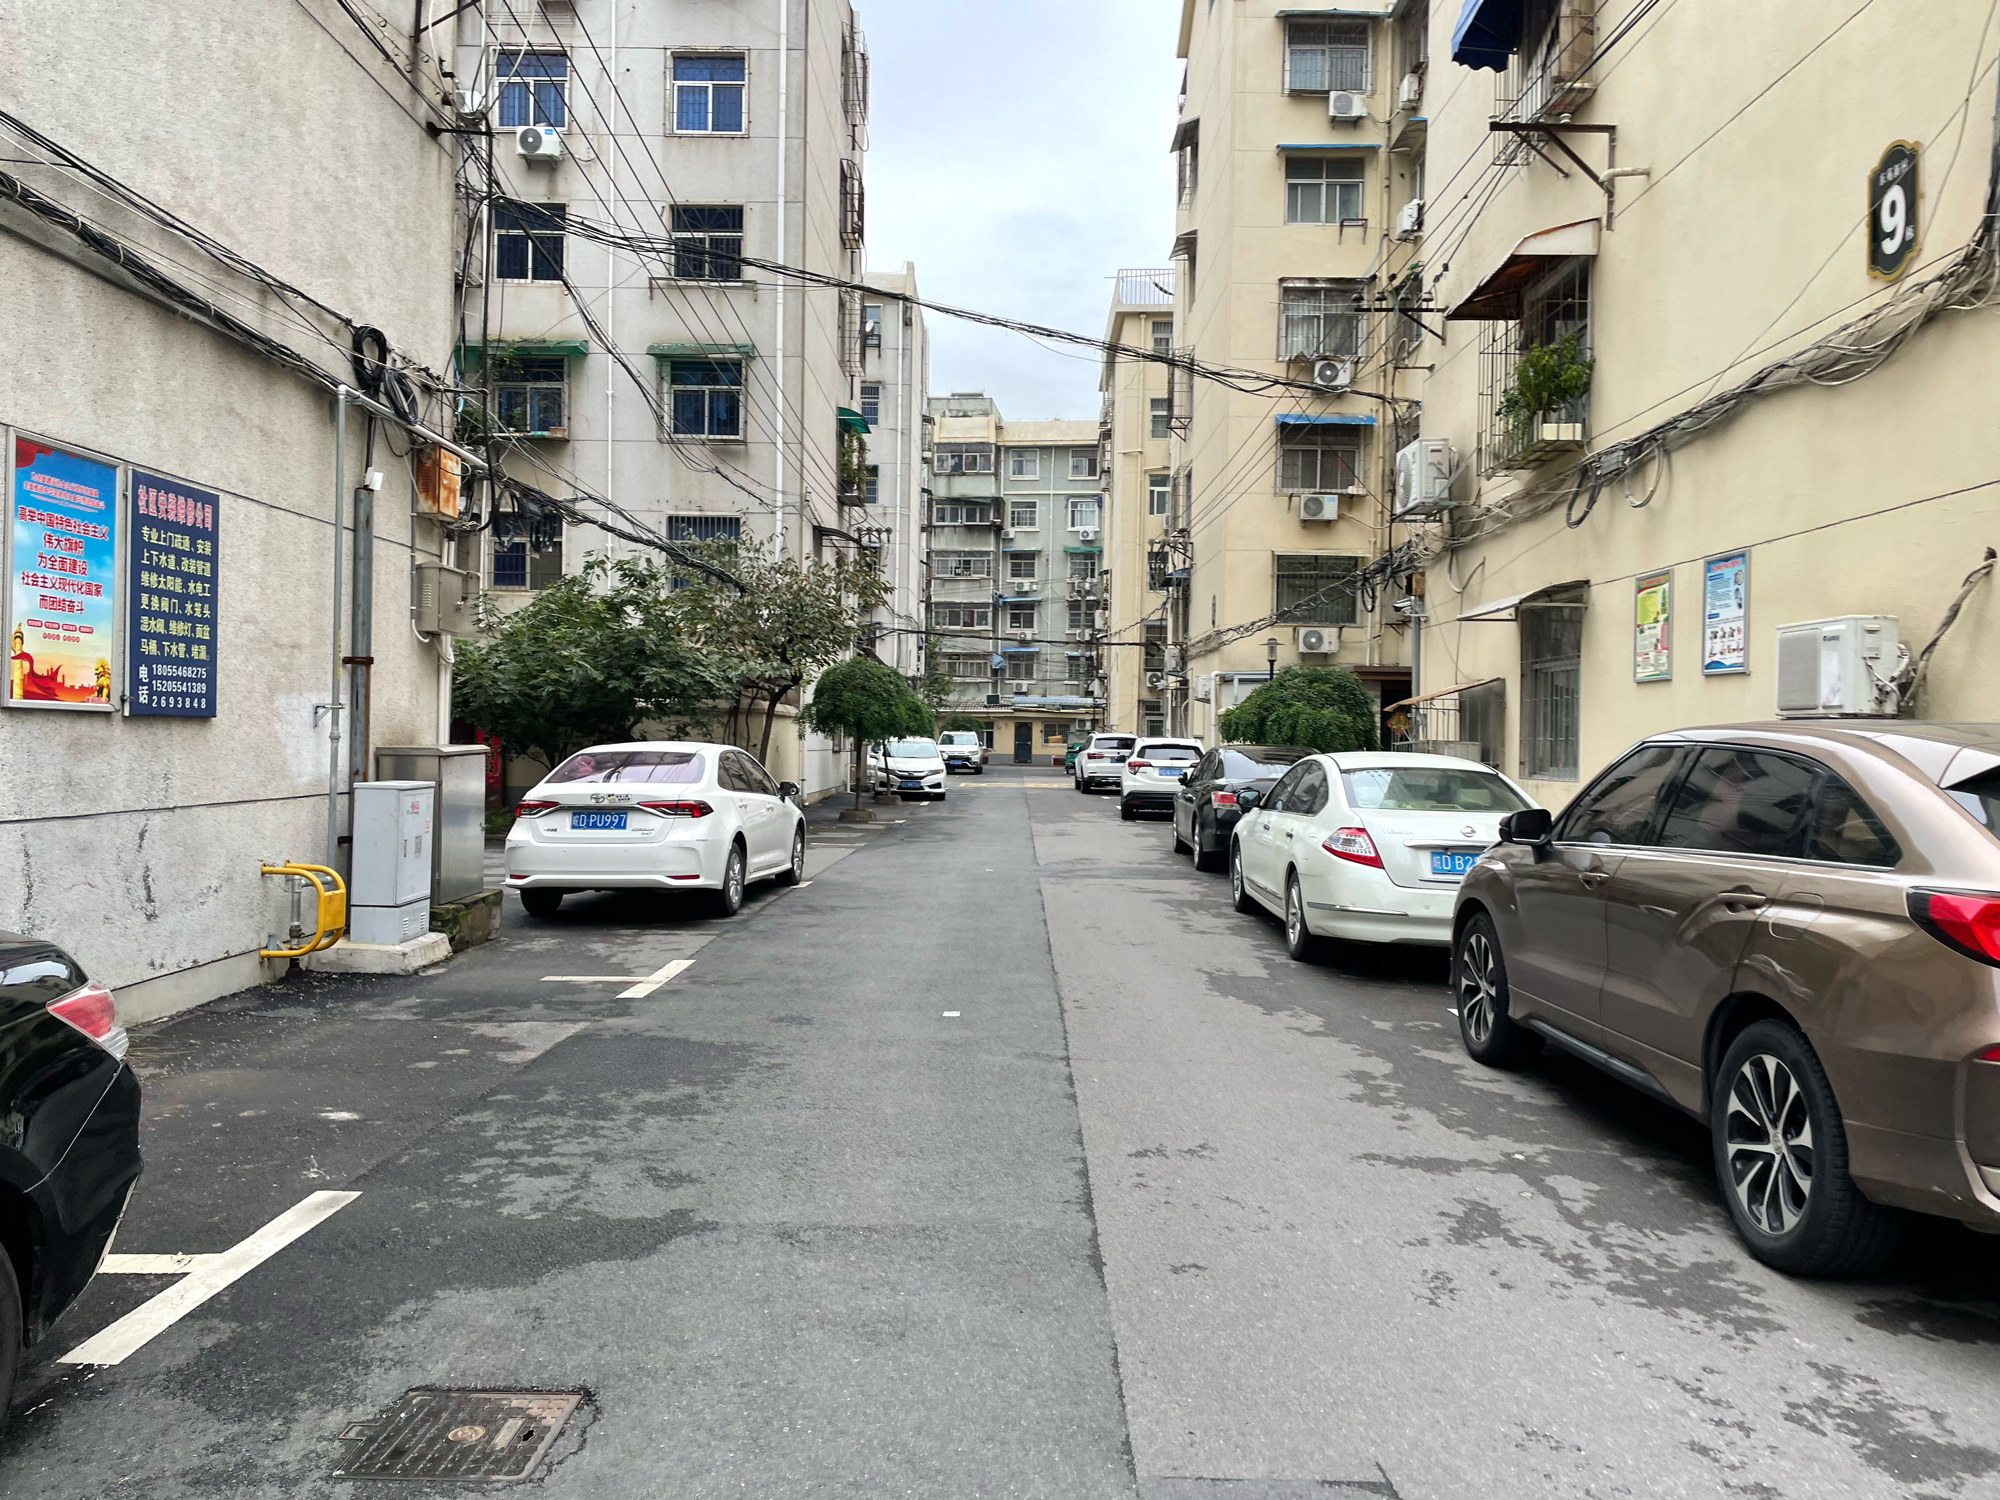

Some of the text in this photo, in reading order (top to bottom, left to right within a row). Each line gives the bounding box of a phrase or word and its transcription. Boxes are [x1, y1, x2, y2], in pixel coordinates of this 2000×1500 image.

[1881, 184, 1906, 254] 9
[138, 484, 212, 532] 社区安装维修公司
[18, 505, 109, 541] 高举中国特色社会主义
[43, 532, 84, 555] 伟大旗帜
[141, 525, 211, 556] 专业上门疏通、安装
[37, 551, 88, 576] 为全面建设
[141, 548, 211, 577] 上下水道、改装管道
[21, 569, 103, 598] 社会主义现代化国家
[140, 570, 211, 596] 维修太阳能、水电工
[38, 594, 85, 614] 而团结奋斗
[138, 664, 149, 704] 电话
[152, 664, 206, 678] 18055468275
[152, 680, 206, 694] 15205541389
